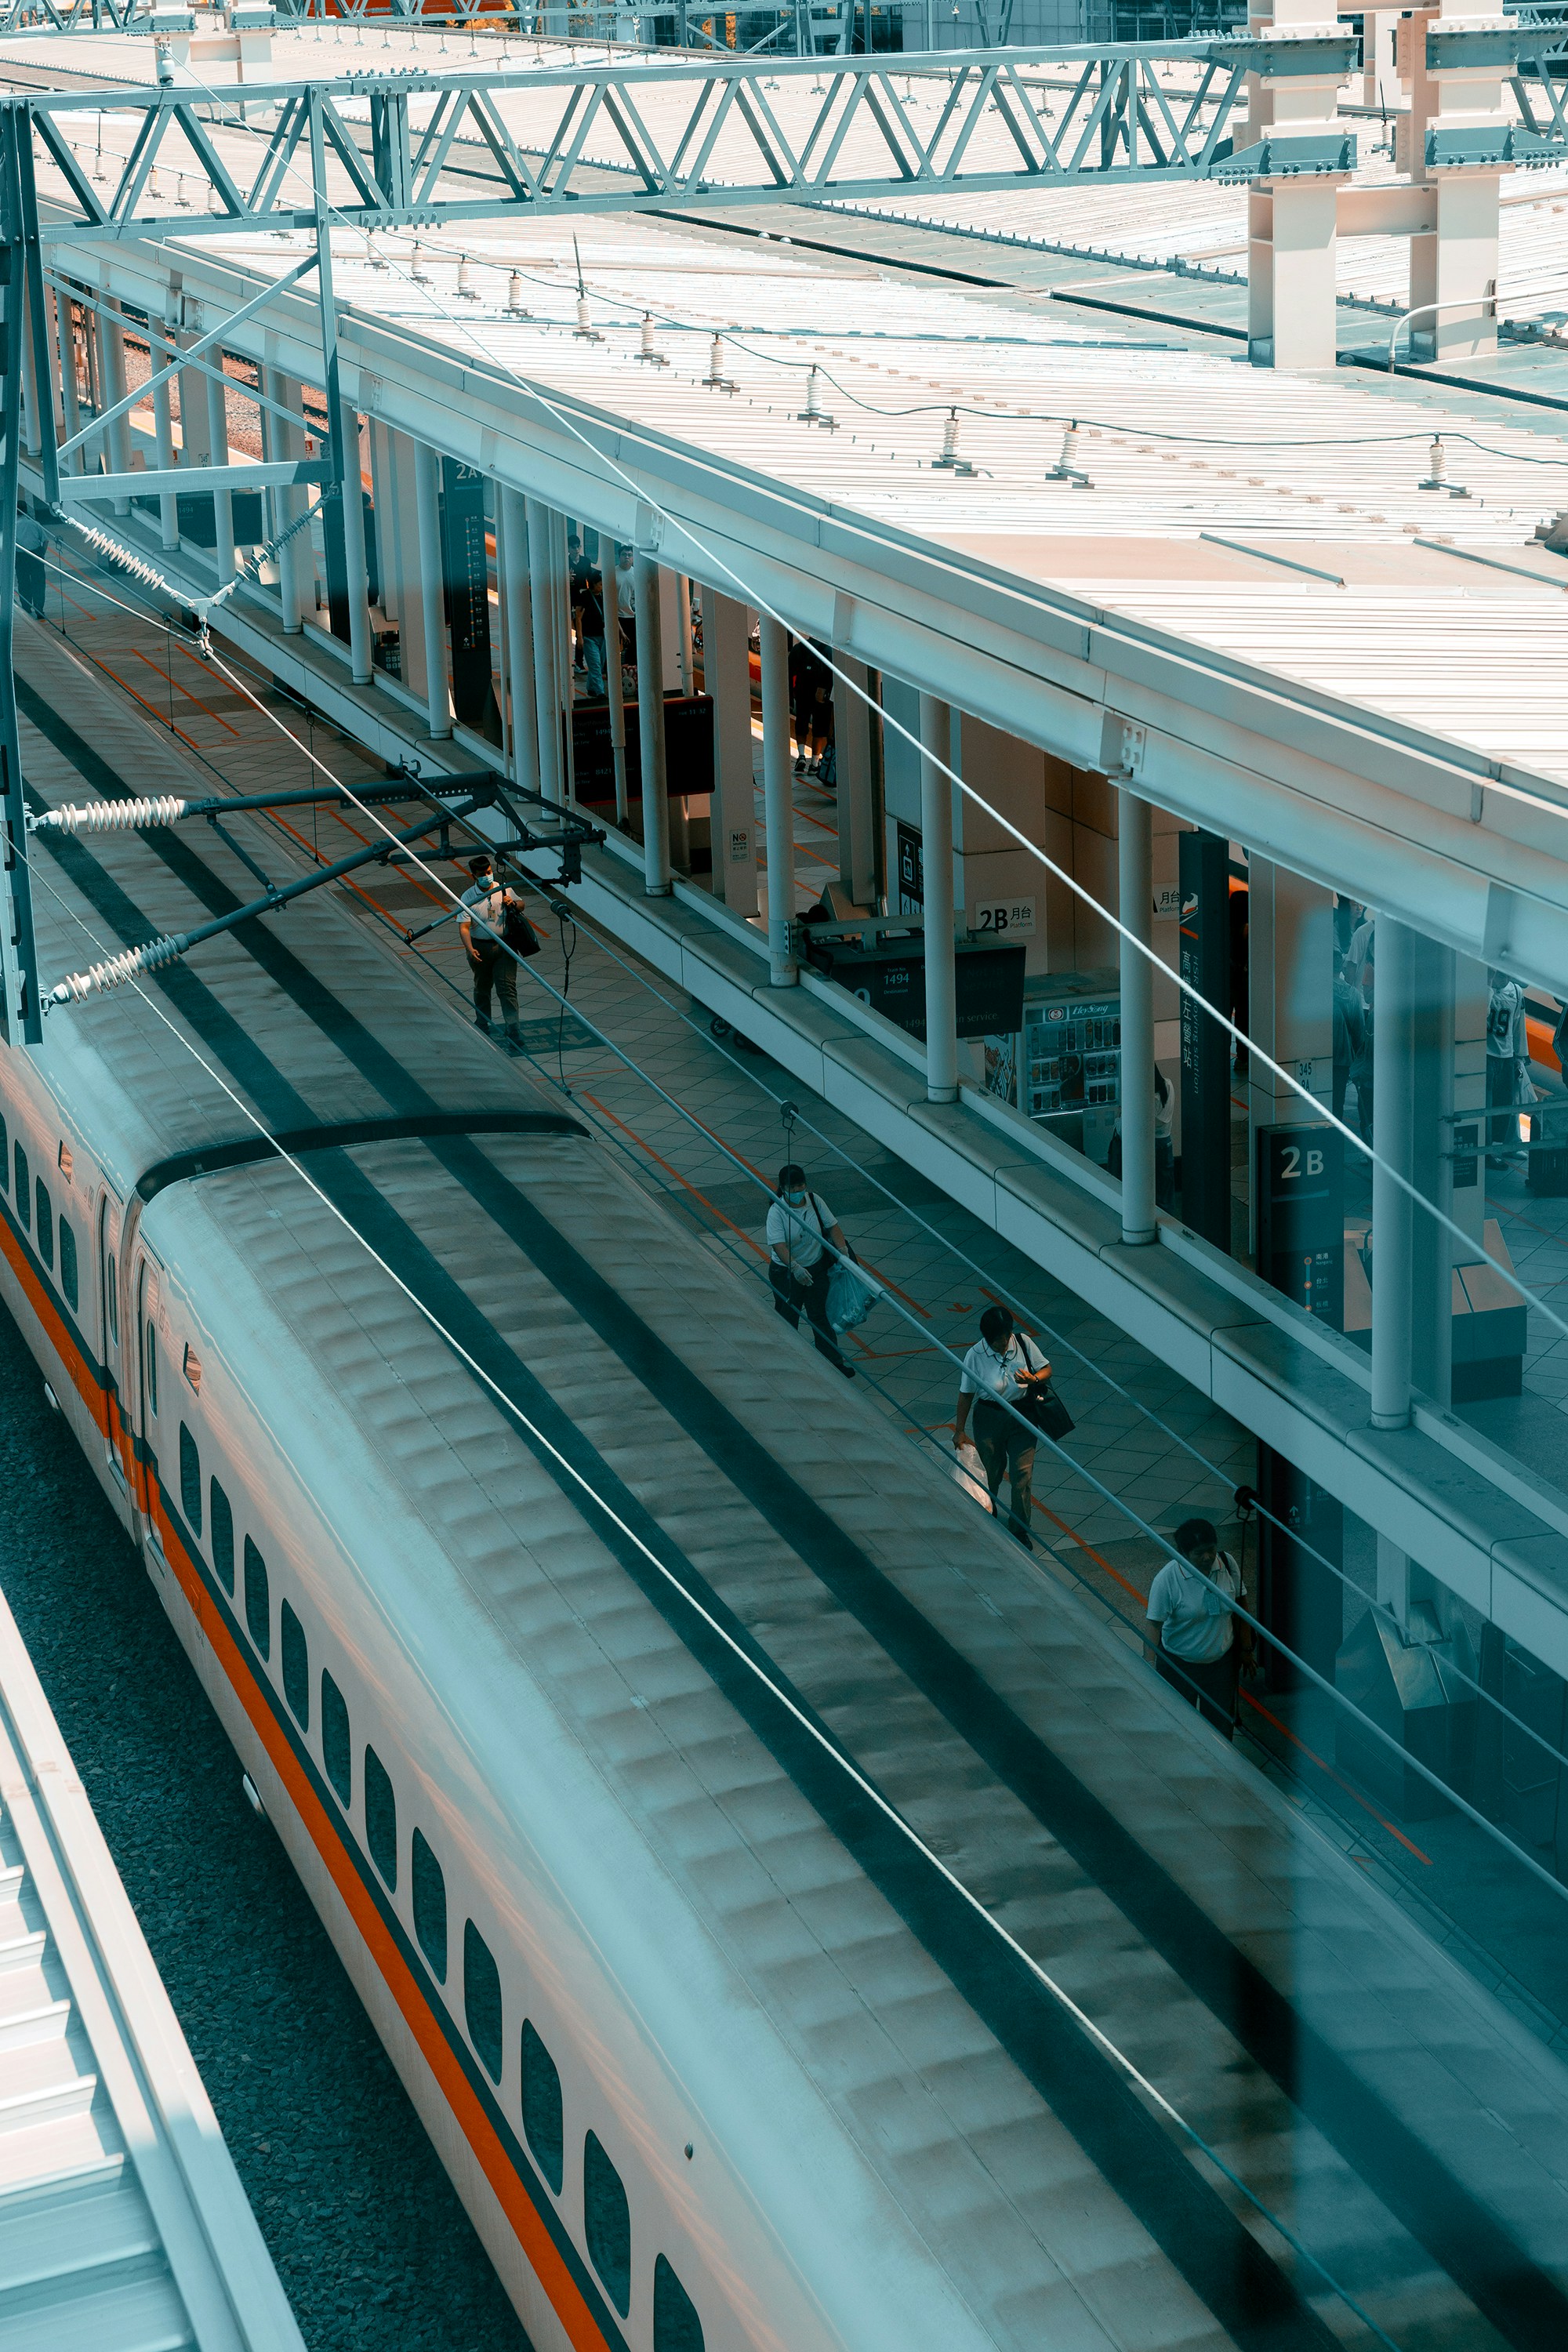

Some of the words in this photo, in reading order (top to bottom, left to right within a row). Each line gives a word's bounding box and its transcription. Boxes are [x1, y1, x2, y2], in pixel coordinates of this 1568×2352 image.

[456, 463, 477, 479] 2A
[1160, 891, 1180, 904] 月台
[980, 909, 1007, 929] 2B
[1011, 906, 1032, 920] 月台
[884, 973, 909, 985] 1494
[905, 1018, 925, 1029] 1494
[1299, 1062, 1312, 1076] 345
[1280, 1146, 1324, 1179] 2B
